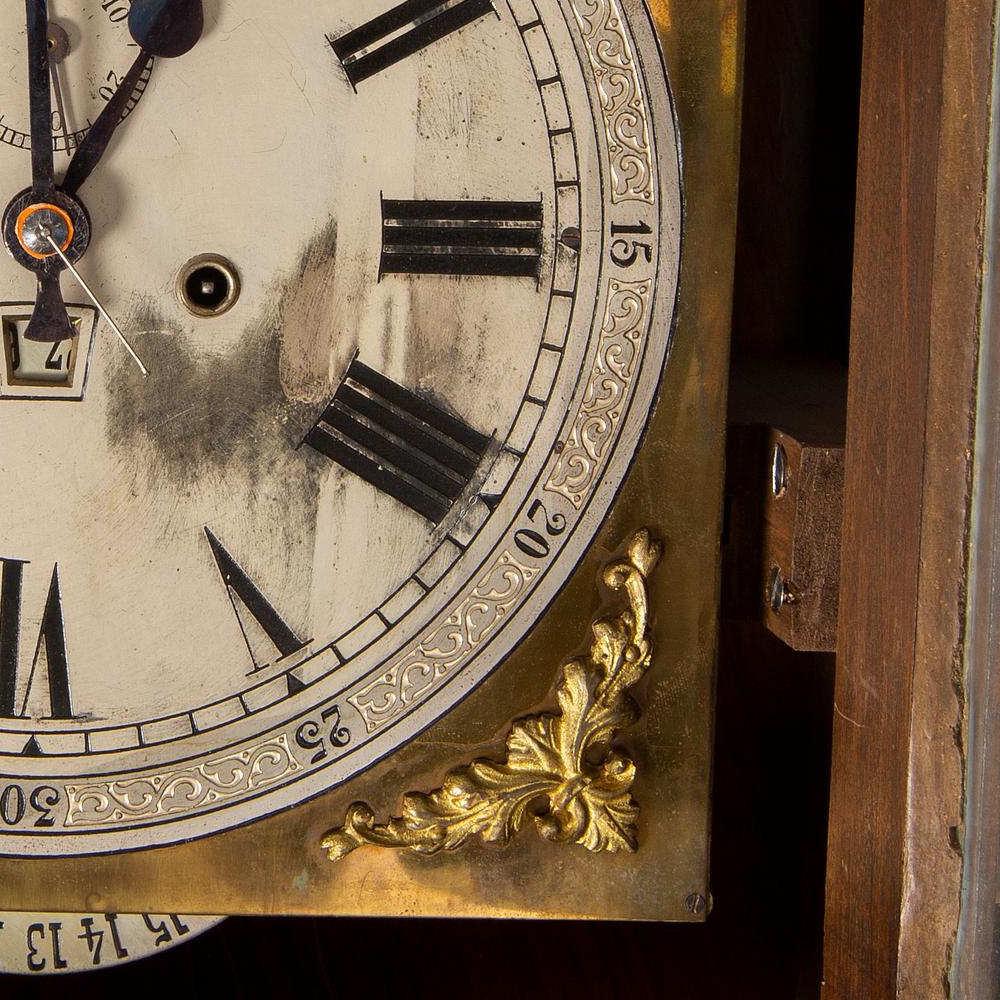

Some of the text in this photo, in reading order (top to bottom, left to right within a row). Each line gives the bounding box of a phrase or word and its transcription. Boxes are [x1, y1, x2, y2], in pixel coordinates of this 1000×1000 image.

[378, 190, 543, 285] III
[609, 219, 653, 269] 15
[296, 348, 498, 536] IIII
[513, 498, 567, 559] 20
[203, 526, 314, 677] V
[295, 704, 351, 765] 25
[0, 784, 61, 828] 30
[26, 921, 69, 971] 13
[77, 912, 129, 965] 14
